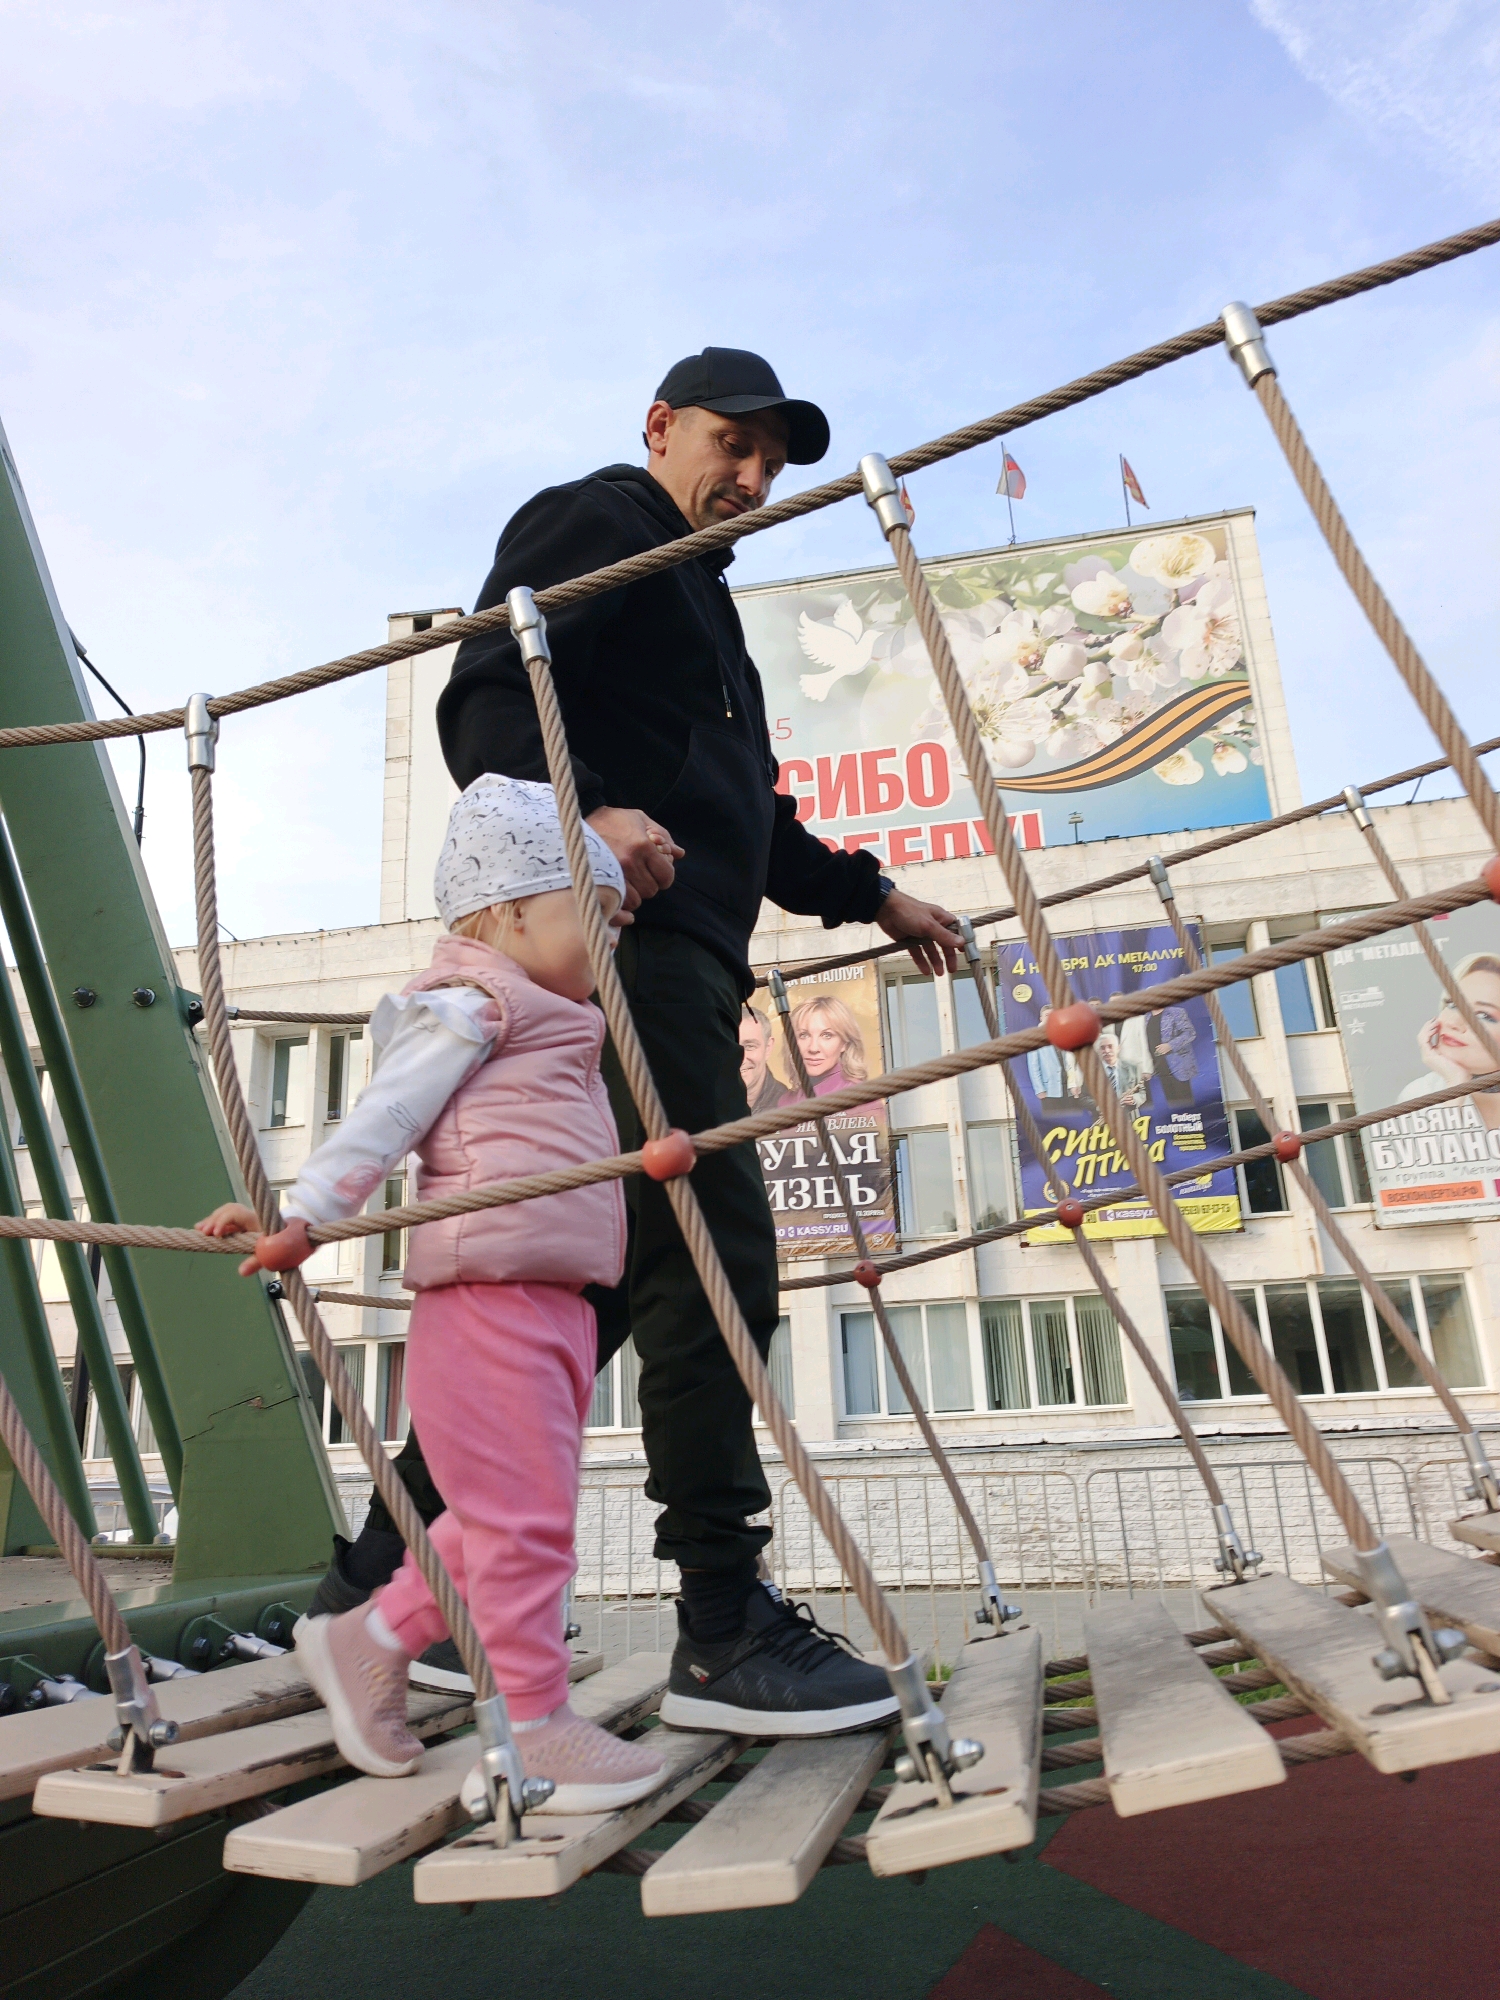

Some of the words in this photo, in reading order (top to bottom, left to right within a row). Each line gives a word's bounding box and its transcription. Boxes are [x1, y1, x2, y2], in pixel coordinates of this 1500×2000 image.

[767, 717, 793, 740] 5
[1012, 958, 1026, 976] 4
[1029, 956, 1090, 975] НБРЯ
[1094, 953, 1116, 968] ДК
[1118, 947, 1186, 965] МЕТАЛЛУР
[1333, 949, 1356, 967] ДК
[795, 1116, 878, 1133] ЯКВЛЕВА
[756, 1132, 881, 1171] УГАЯ
[1396, 1170, 1446, 1185] группа
[797, 1224, 849, 1236] KASSY.RU
